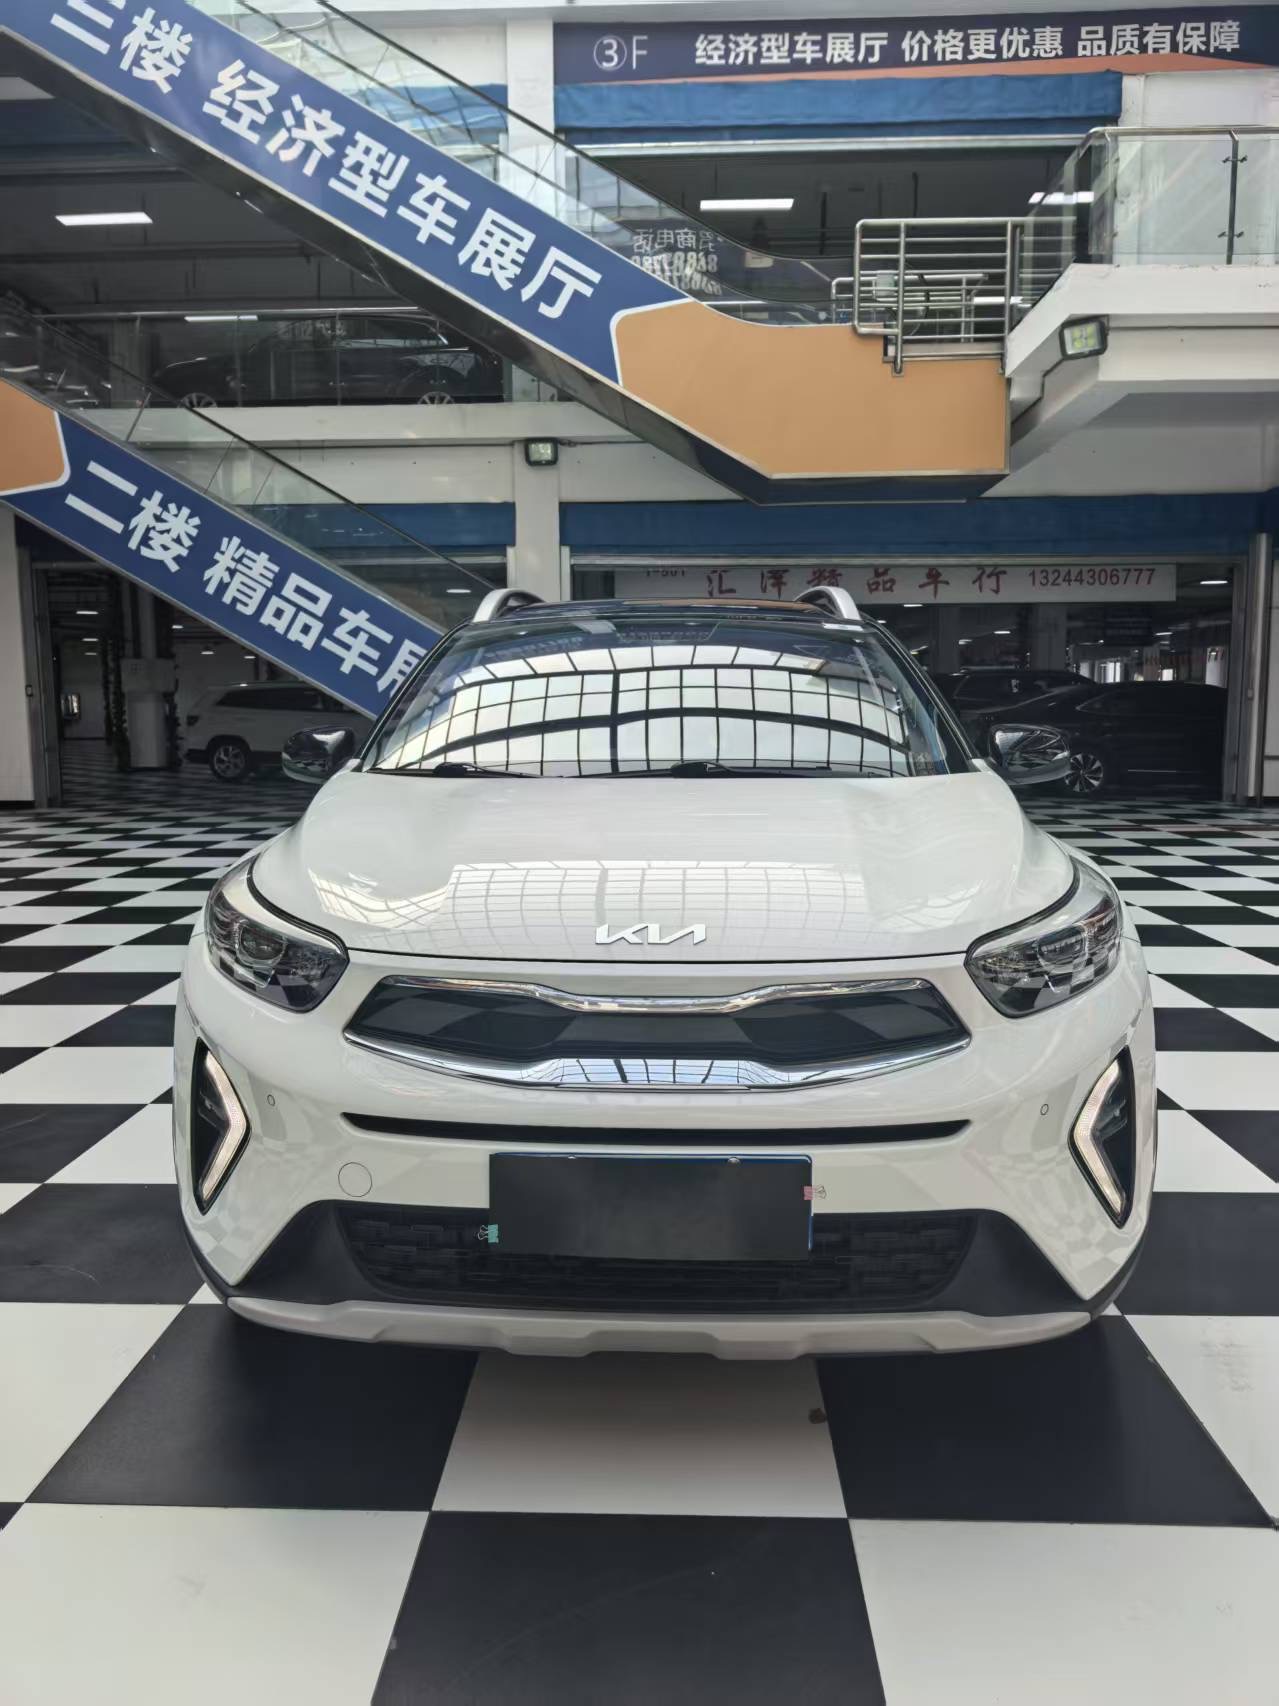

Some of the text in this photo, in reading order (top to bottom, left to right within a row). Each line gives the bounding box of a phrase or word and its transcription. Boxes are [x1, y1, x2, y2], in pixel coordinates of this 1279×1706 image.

[695, 31, 889, 66] 经济型车展厅
[901, 26, 1064, 62] 价格更优惠
[1077, 20, 1241, 56] 品质有保障
[50, 0, 601, 319] 三楼 经济型车展厅
[65, 461, 201, 573] 二楼
[1028, 568, 1156, 587] 13244306777
[595, 923, 707, 945] KIA
